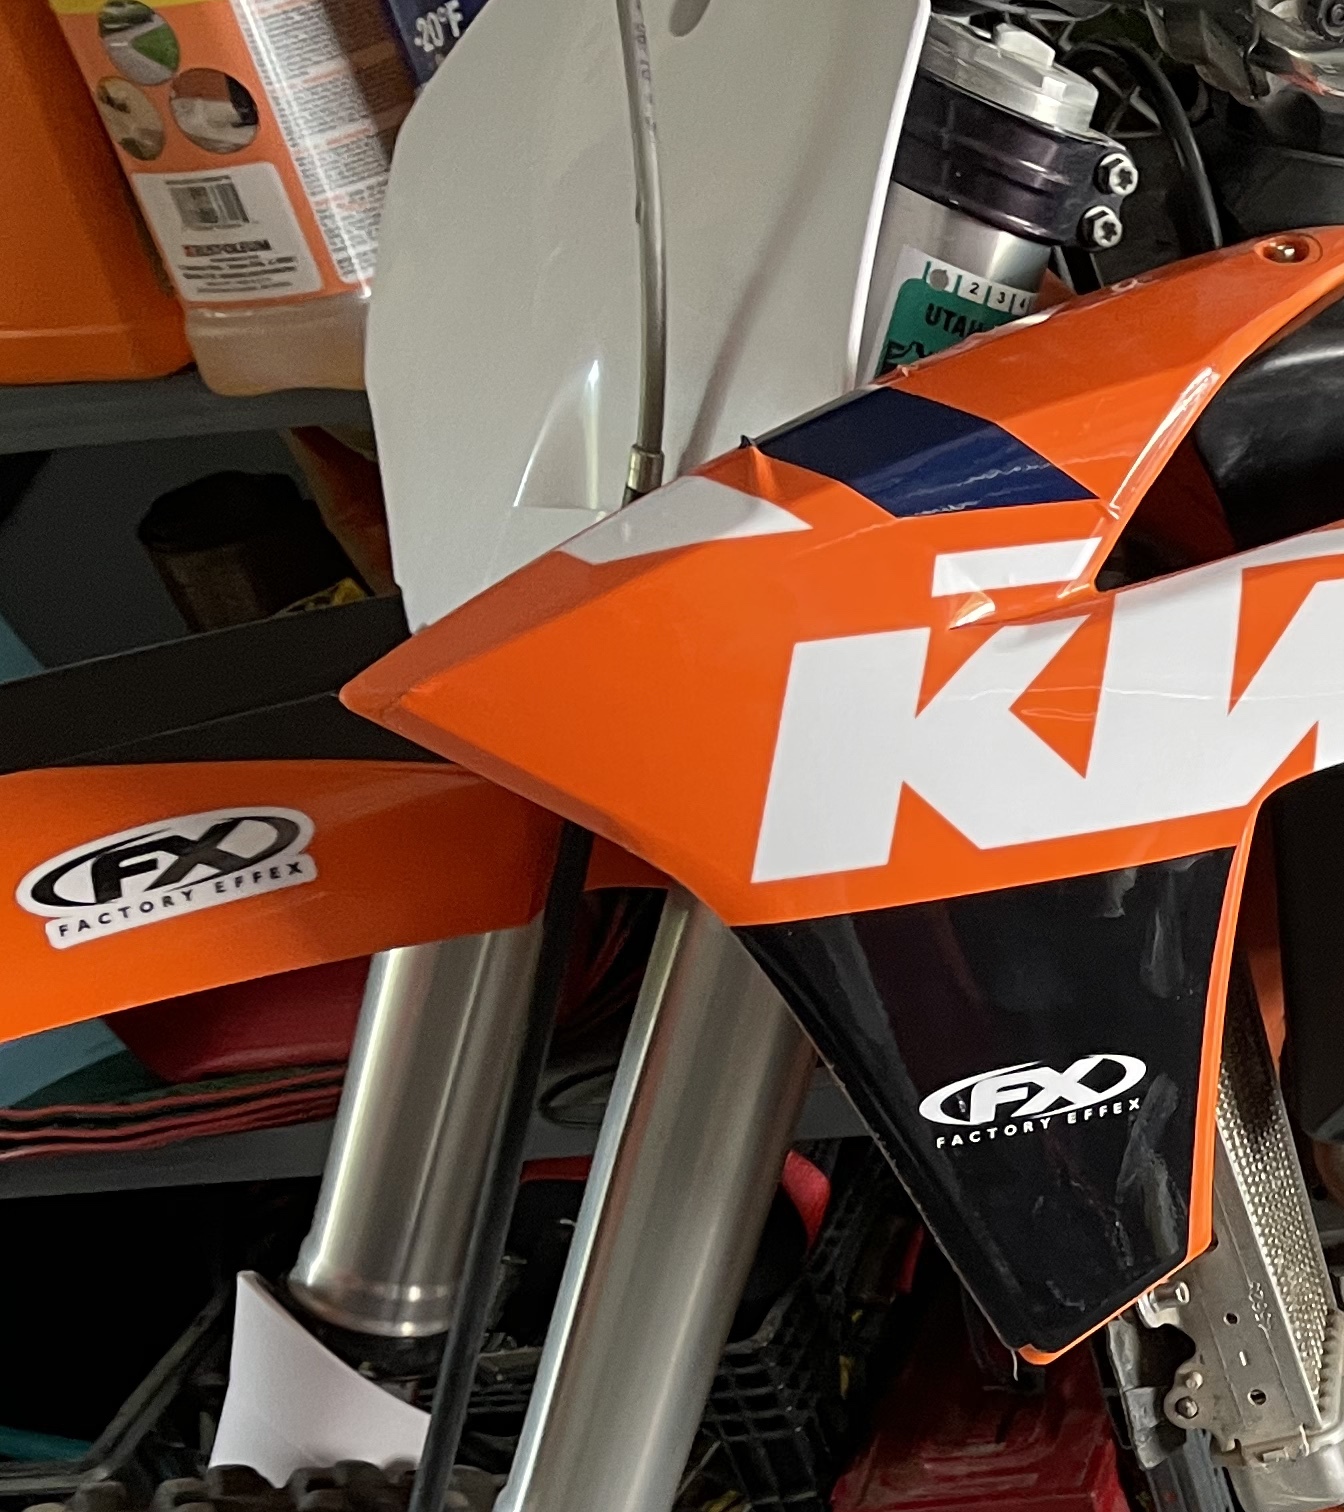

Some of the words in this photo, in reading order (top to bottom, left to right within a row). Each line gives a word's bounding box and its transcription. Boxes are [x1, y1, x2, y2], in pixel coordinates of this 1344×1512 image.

[925, 302, 984, 338] UTAH
[969, 282, 980, 296] 2
[997, 291, 1006, 304] 3
[91, 816, 252, 905] FX
[57, 888, 194, 938] FACTORY
[213, 861, 304, 894] EFFEX
[968, 1055, 1106, 1125] FX
[936, 1117, 1051, 1149] FACTORY
[1066, 1097, 1141, 1125] EFFEX
